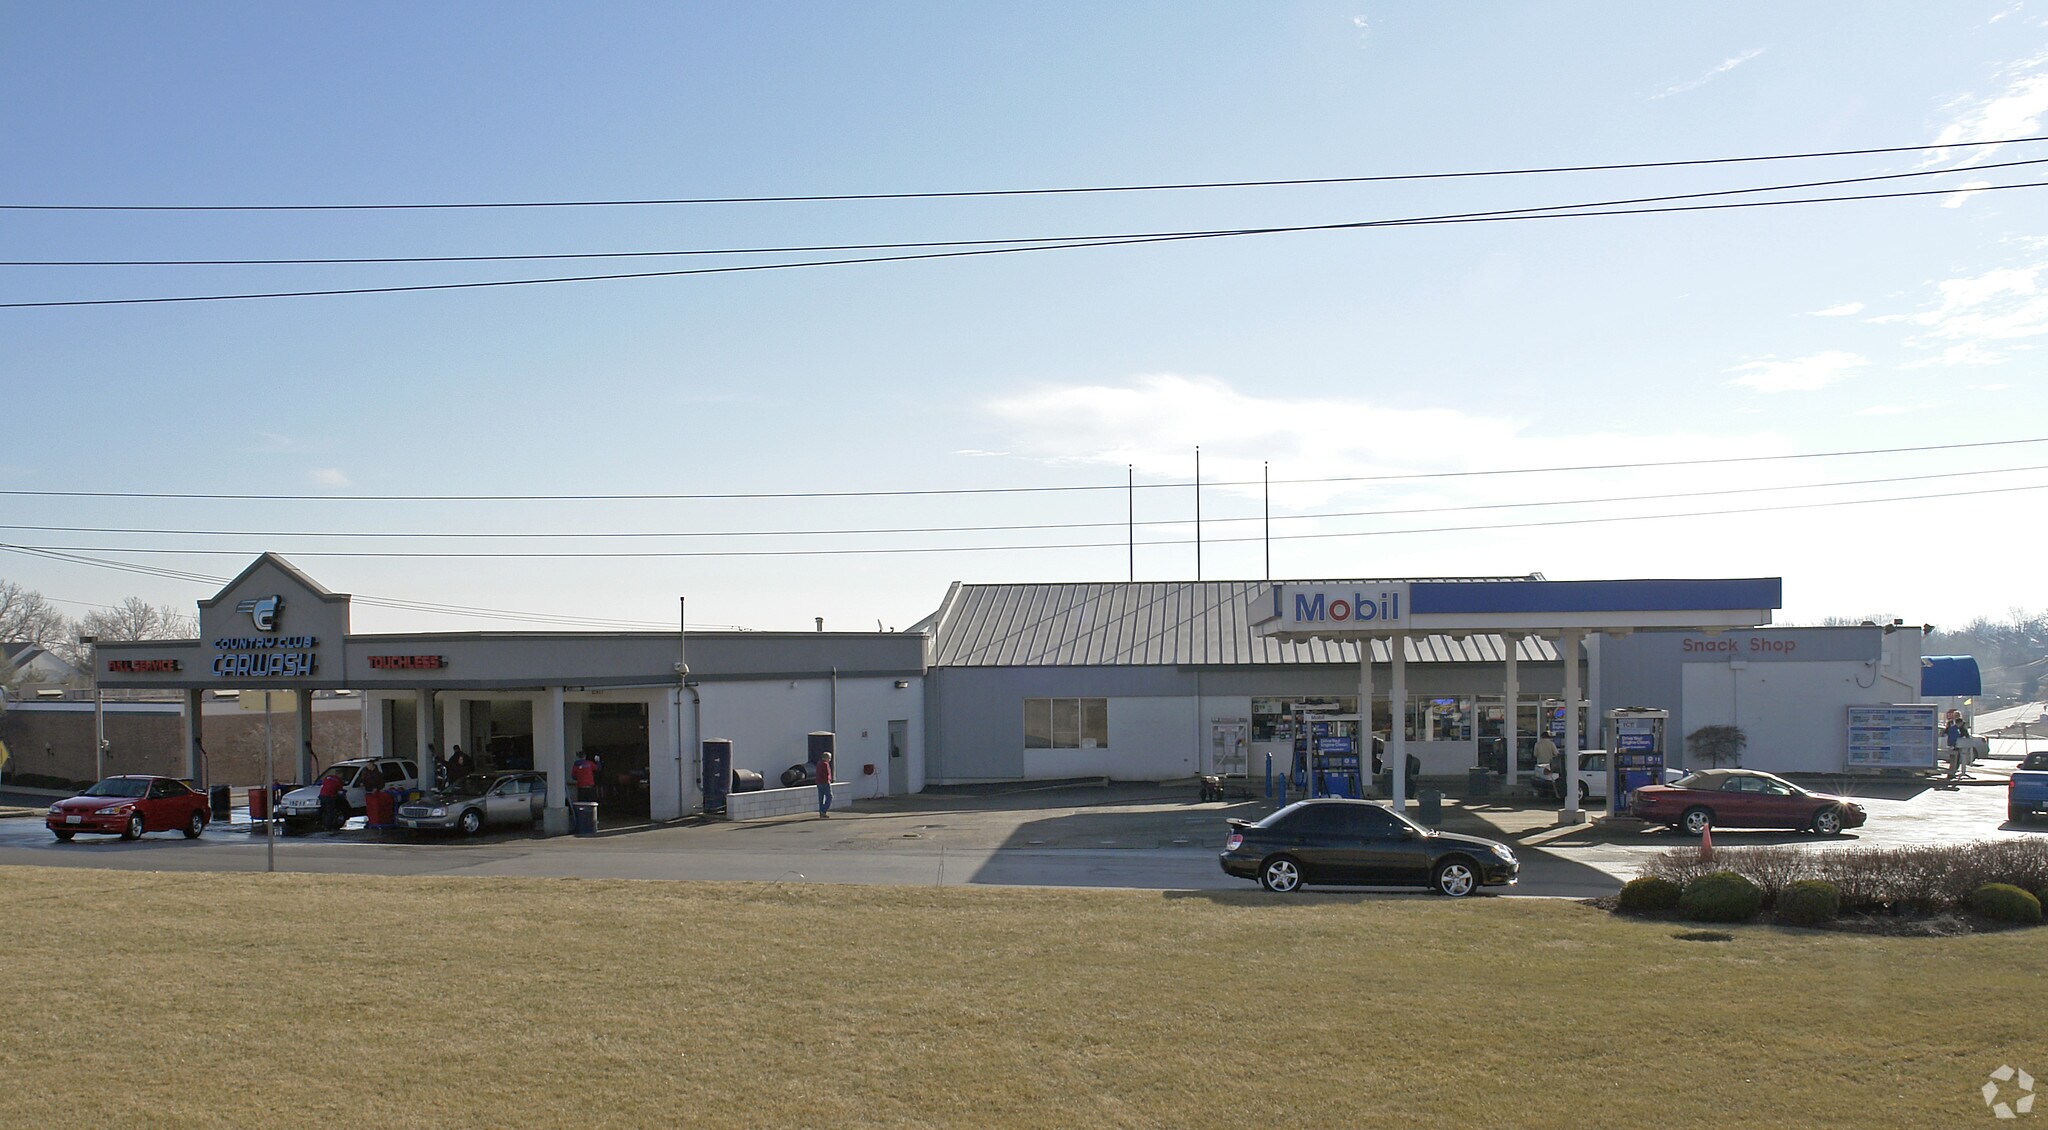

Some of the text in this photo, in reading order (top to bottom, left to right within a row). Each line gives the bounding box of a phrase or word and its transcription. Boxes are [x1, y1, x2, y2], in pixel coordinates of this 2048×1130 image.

[1295, 592, 1399, 621] Mobil
[213, 636, 315, 650] COUNTRY CLUB
[1683, 637, 1796, 653] Snack Shop
[107, 659, 176, 672] FULL SERVICE
[211, 653, 315, 677] CARWASH
[367, 655, 443, 669] TOUCHLESS
